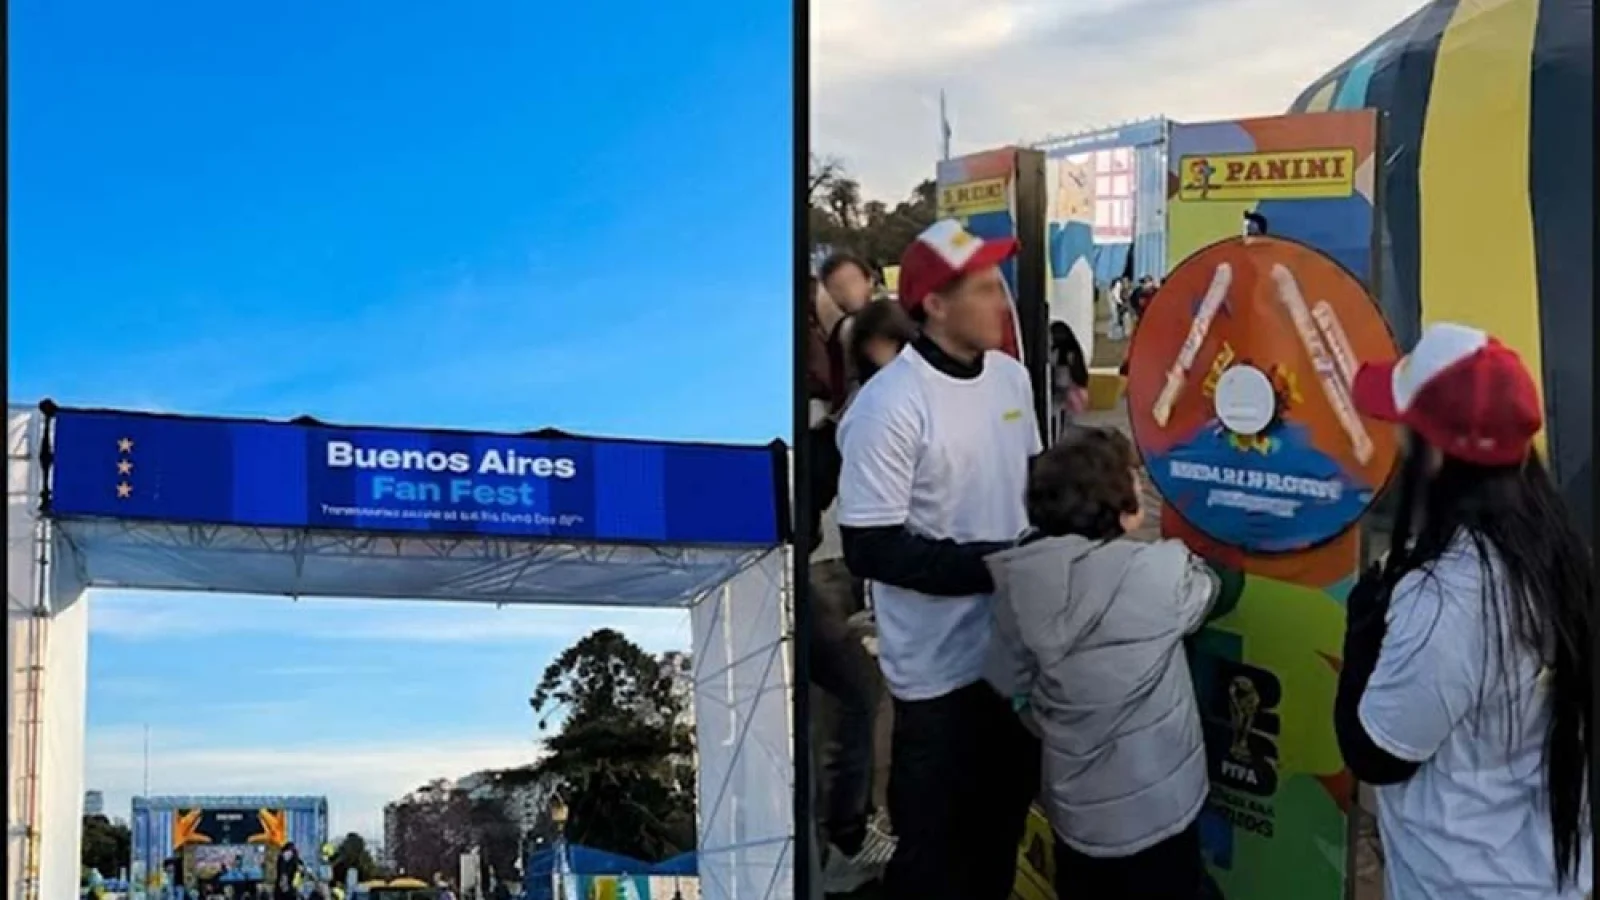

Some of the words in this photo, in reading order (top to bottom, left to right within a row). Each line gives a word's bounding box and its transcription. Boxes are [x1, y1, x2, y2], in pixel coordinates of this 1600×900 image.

[1225, 156, 1346, 183] PANINI
[327, 441, 470, 472] Buenos
[478, 449, 577, 478] Aires
[371, 475, 441, 502] Fan
[450, 479, 535, 506] Fest
